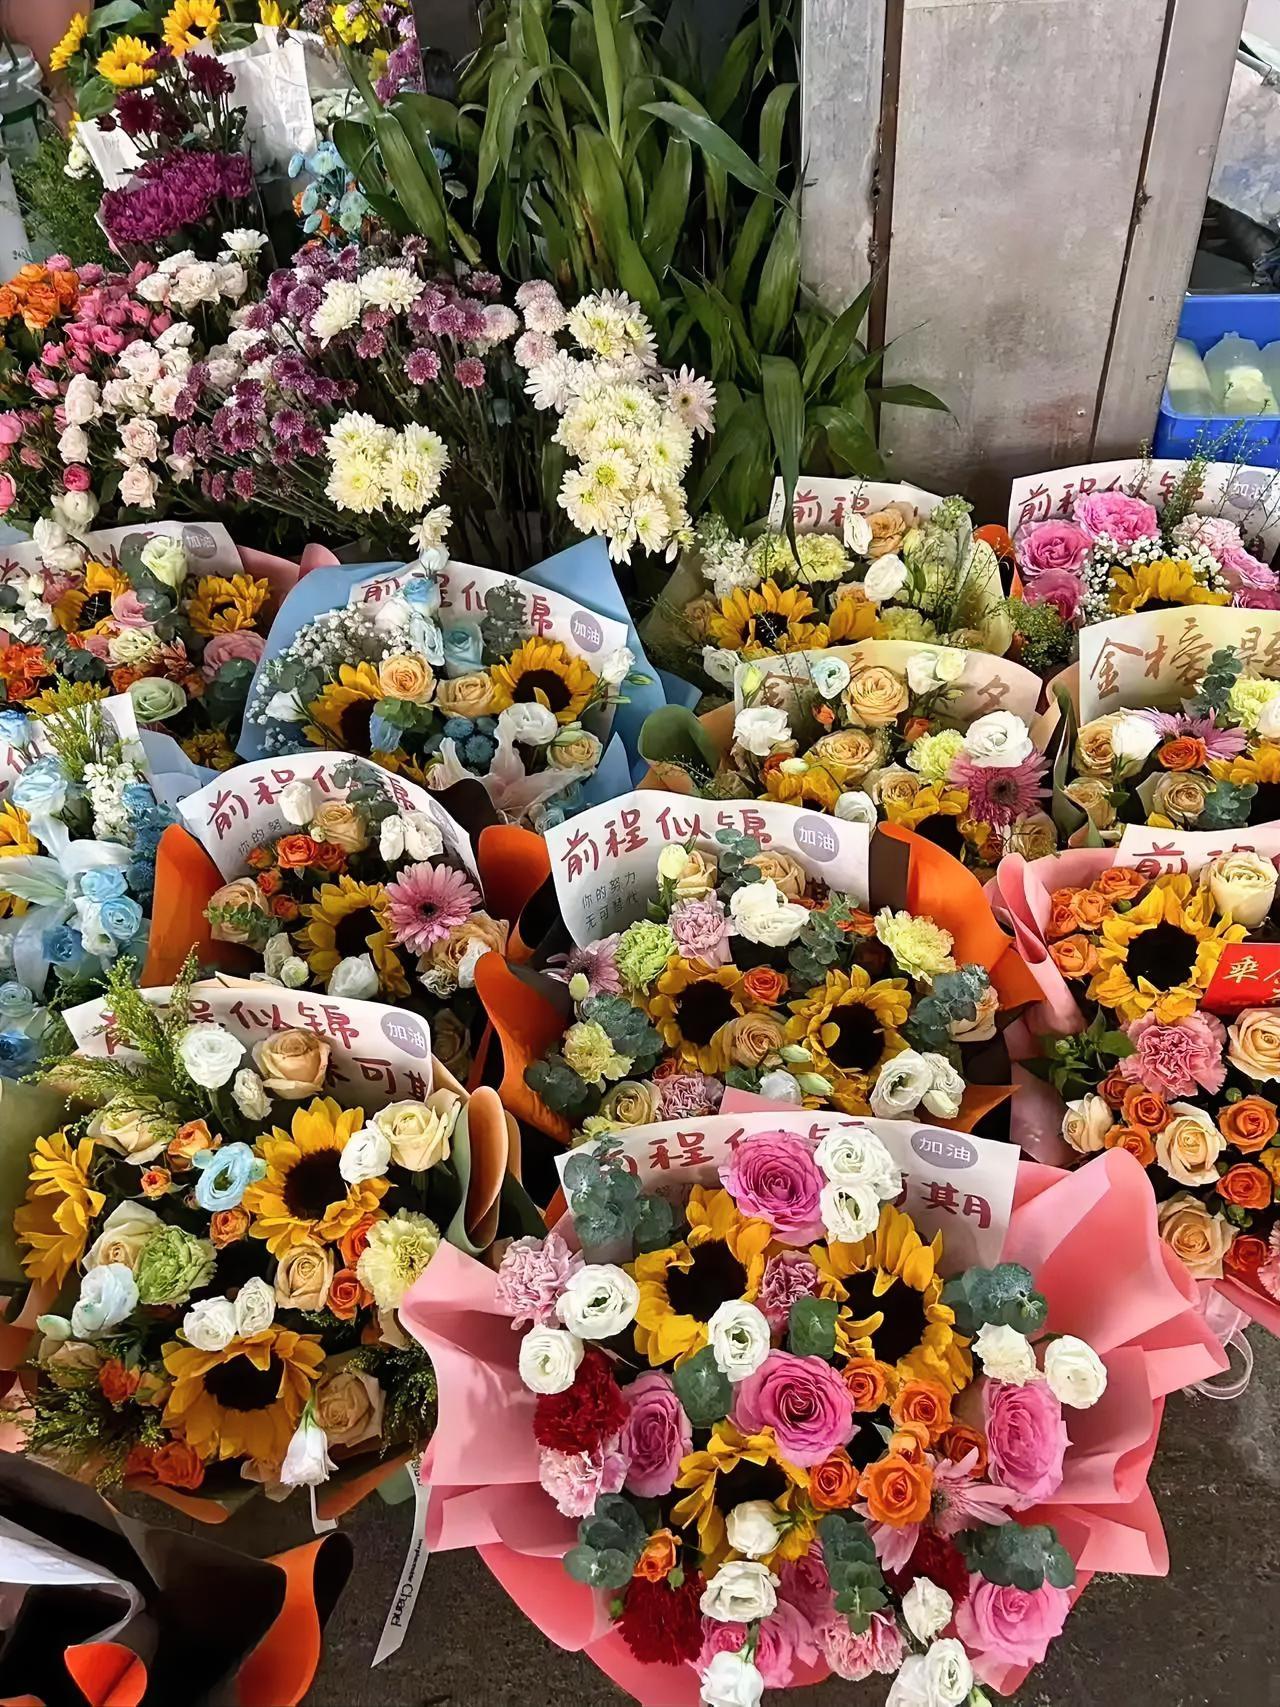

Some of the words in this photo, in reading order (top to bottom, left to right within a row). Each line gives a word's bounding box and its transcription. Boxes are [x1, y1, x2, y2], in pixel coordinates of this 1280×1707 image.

[573, 619, 600, 645] 加油
[798, 825, 835, 853] 加油
[582, 871, 636, 910] 你的努力
[386, 1021, 426, 1049] 加油
[918, 1132, 973, 1163] 加油
[390, 1583, 415, 1628] Chanel
